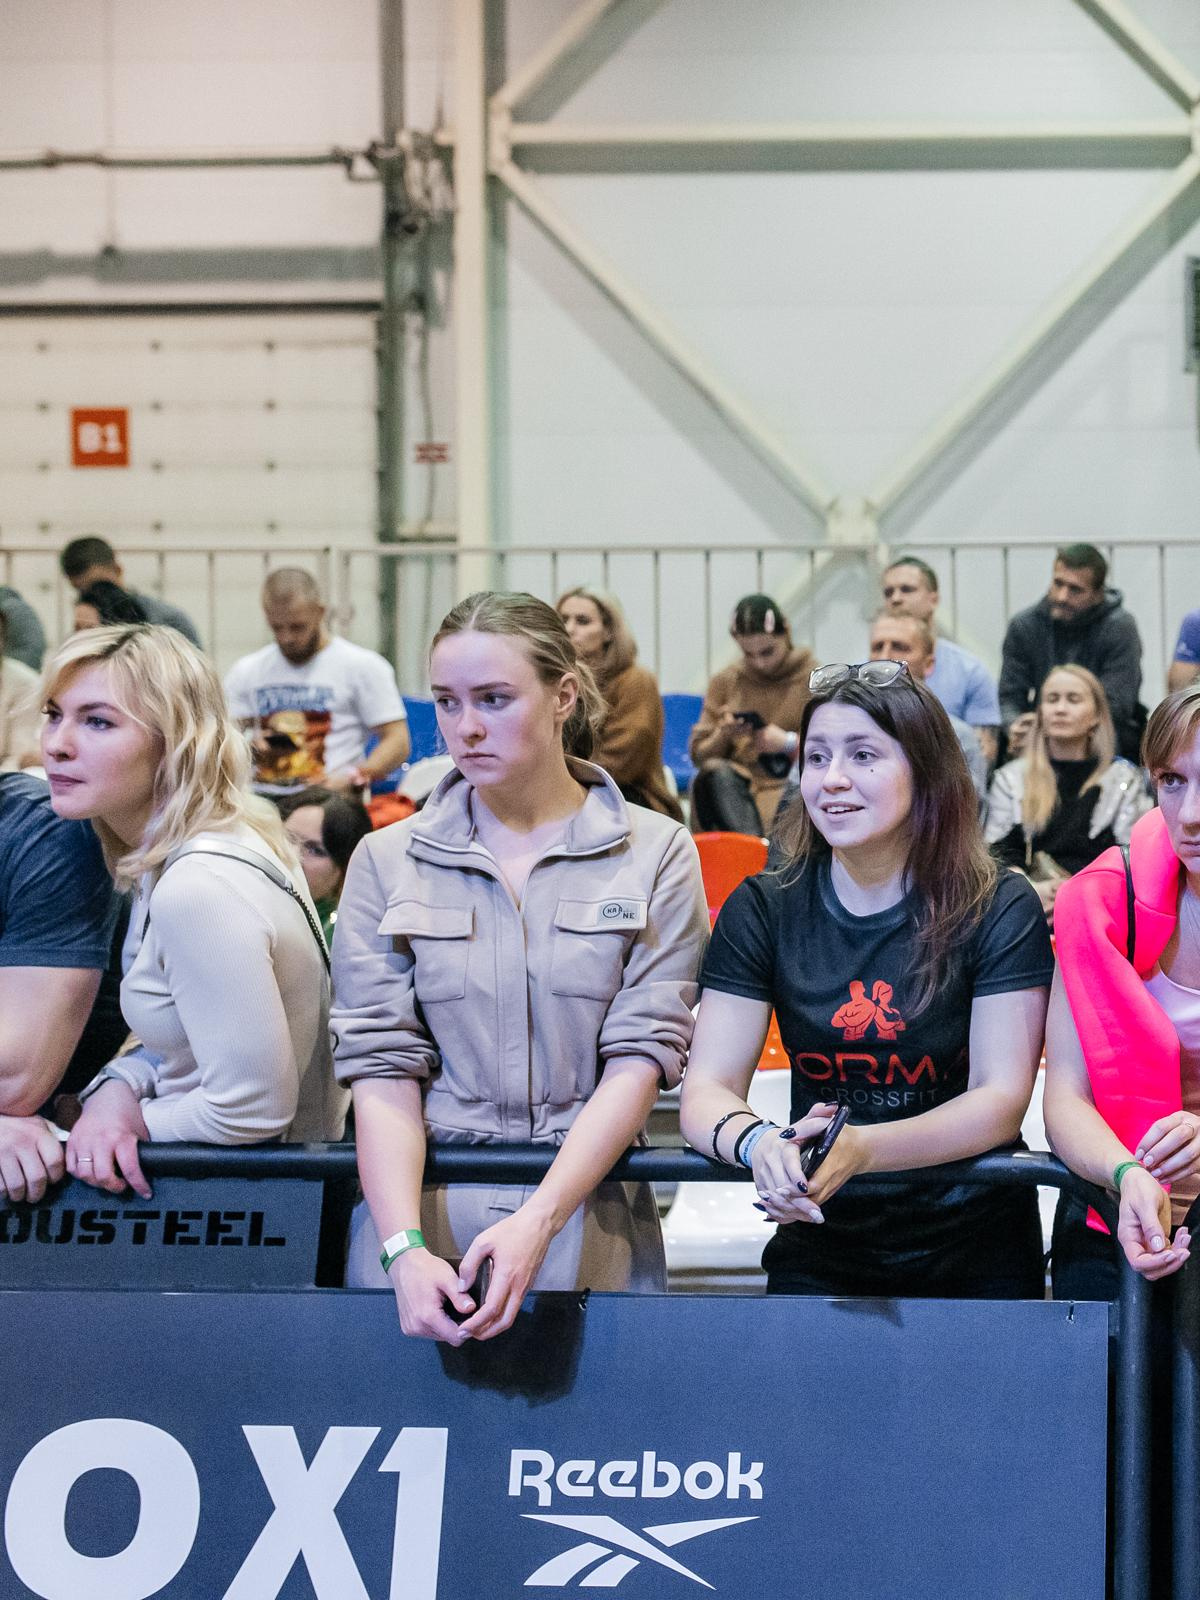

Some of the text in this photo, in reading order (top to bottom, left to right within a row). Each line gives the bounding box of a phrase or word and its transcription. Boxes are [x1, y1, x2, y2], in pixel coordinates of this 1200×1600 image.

[79, 421, 122, 454] B1
[820, 1087, 938, 1107] CROSSFIT
[508, 1449, 763, 1507] Reebok
